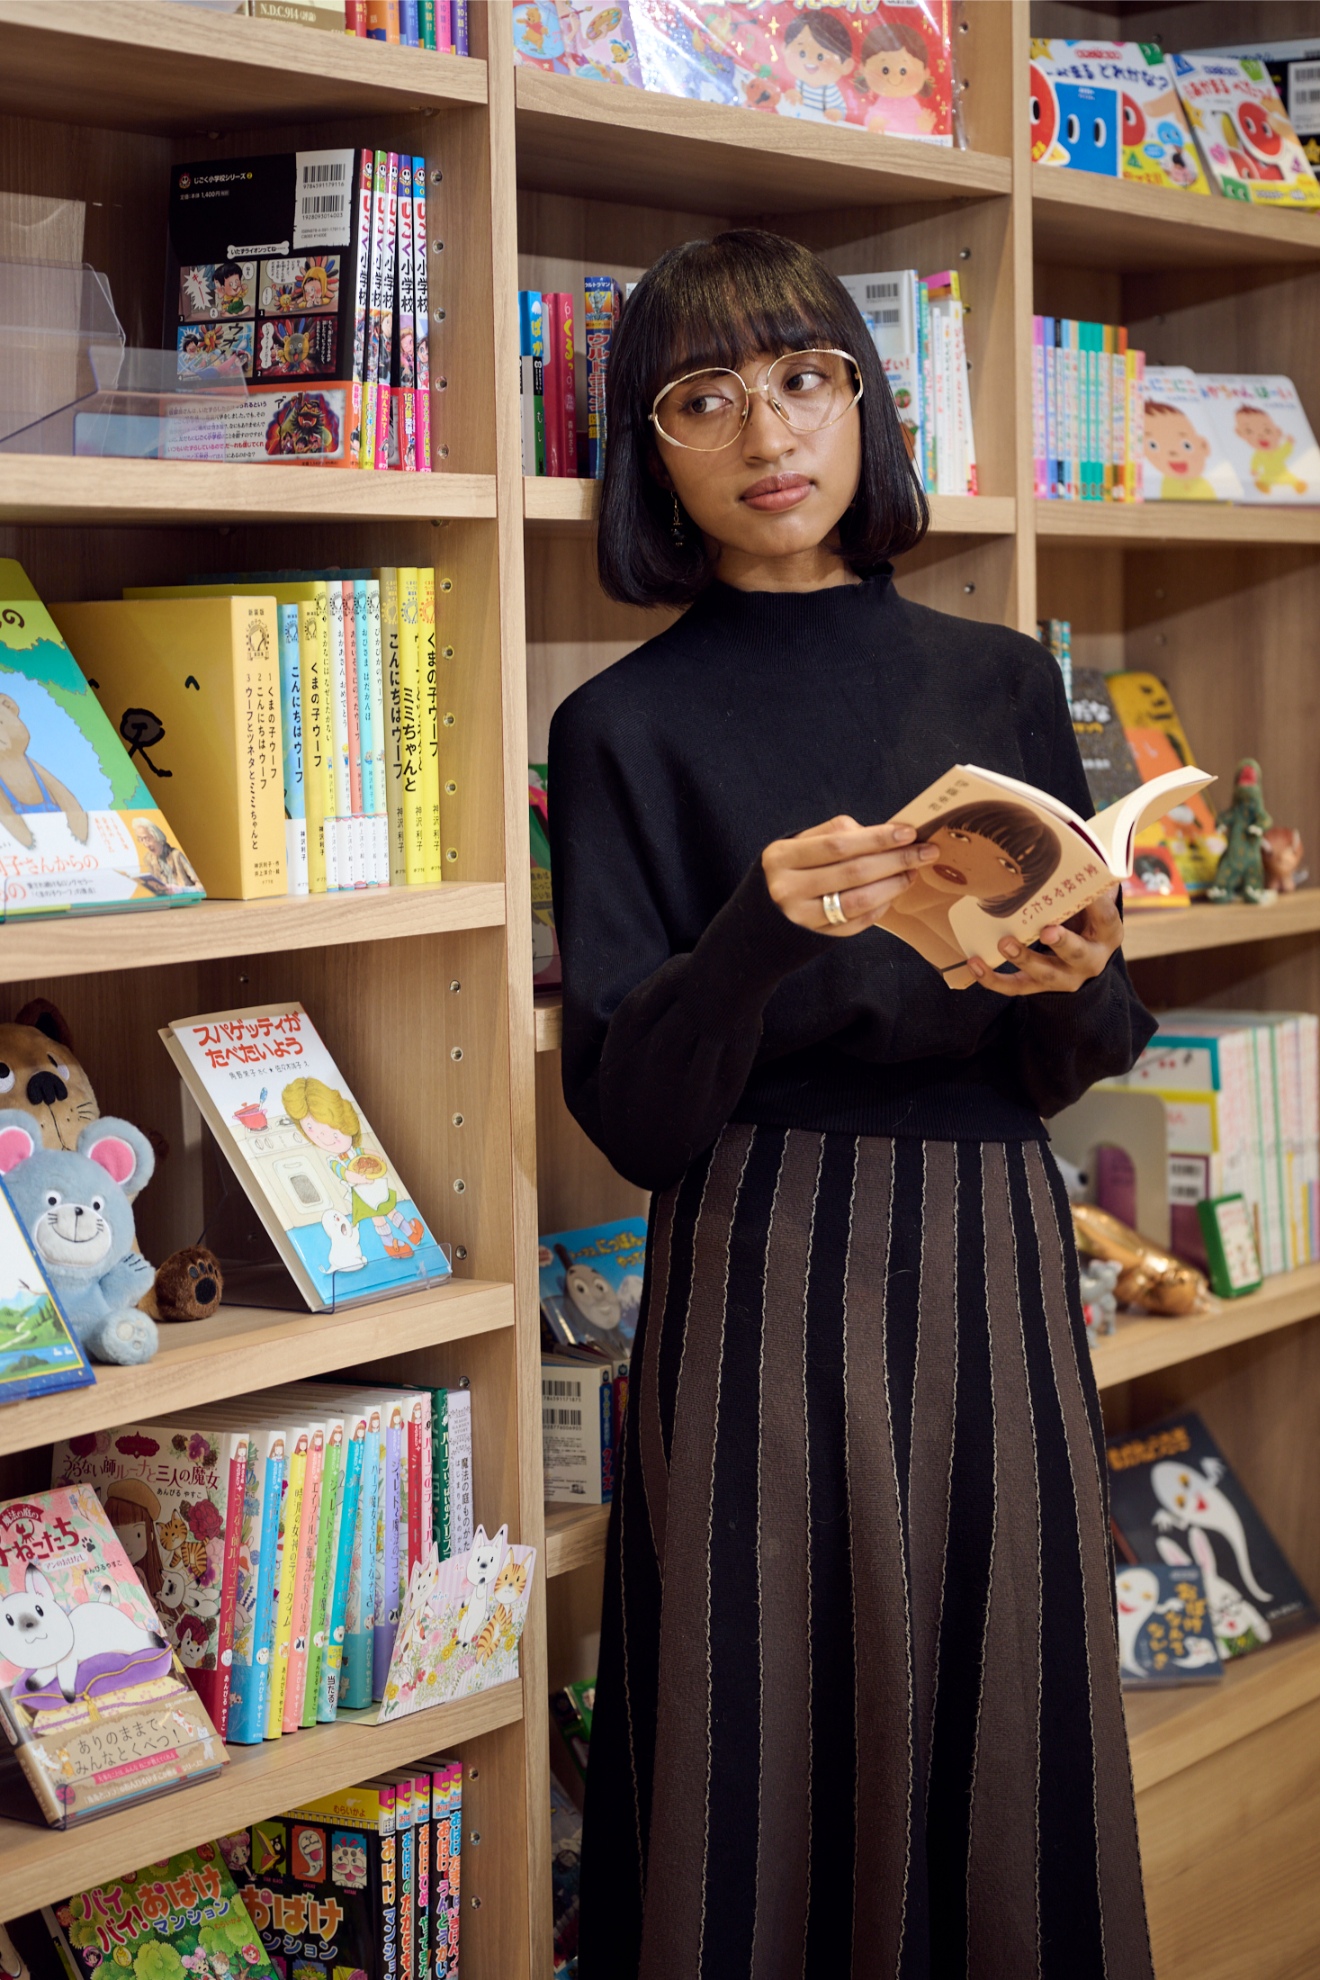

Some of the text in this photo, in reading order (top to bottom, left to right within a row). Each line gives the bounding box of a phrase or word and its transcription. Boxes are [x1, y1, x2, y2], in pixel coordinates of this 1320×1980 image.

[193, 172, 247, 185] じごく小学校シリーズ
[401, 201, 414, 313] じごく小学校
[416, 201, 428, 313] じごく小学校
[310, 662, 322, 767] くまの子ウーフ
[389, 634, 402, 779] こんにちはウーフ
[427, 632, 438, 758] くまの子ウーフ
[257, 686, 267, 790] こんにちはウーフ
[267, 686, 277, 779] くまの子ウーフ
[291, 666, 303, 783] こんにちはウーフ
[402, 688, 417, 793] ミミちゃんと
[245, 687, 258, 850] ウーフとツネタとミミちゃんと
[415, 806, 423, 851] 神沢利子
[0, 853, 99, 877] 子さんからの
[192, 1010, 302, 1046] スパゲッティが
[205, 1036, 303, 1069] たべたいよう
[62, 1455, 221, 1491] うらない師ルーナと三人の魔女
[156, 1486, 203, 1499] あんびる やすこ
[440, 1431, 451, 1560] ハーブいっぱいのクリスマ
[2, 1508, 40, 1526] 魔法の庭の
[422, 1437, 432, 1562] ハーブのティーパー
[461, 1457, 471, 1553] 魔法の庭ものがた
[45, 1553, 87, 1570] アンのおはなし
[82, 1560, 124, 1576] あんびるやすこ
[218, 1493, 243, 1648] うらない師ルーナと三人の魔女
[282, 1487, 303, 1628] 時間の女神のティータイム
[299, 1481, 319, 1635] エイプリルと魔法のおくりもの
[255, 1671, 267, 1728] あんびる やすこ
[294, 1660, 303, 1692] あんびる
[326, 1674, 337, 1713] 当たる!
[220, 1675, 230, 1732] あんびる やすこ
[74, 1729, 181, 1776] みんなとくべつ!
[77, 1717, 168, 1755] ありのままで、
[332, 1804, 367, 1818] むらいかよ
[82, 1888, 124, 1920] バイ
[136, 1864, 222, 1920] おばけ
[152, 1900, 230, 1935] マンション
[240, 1884, 344, 1943] おばけ
[96, 1905, 150, 1954] バイ!
[214, 1915, 242, 1930] むらいかよ
[262, 1932, 338, 1961] ンション
